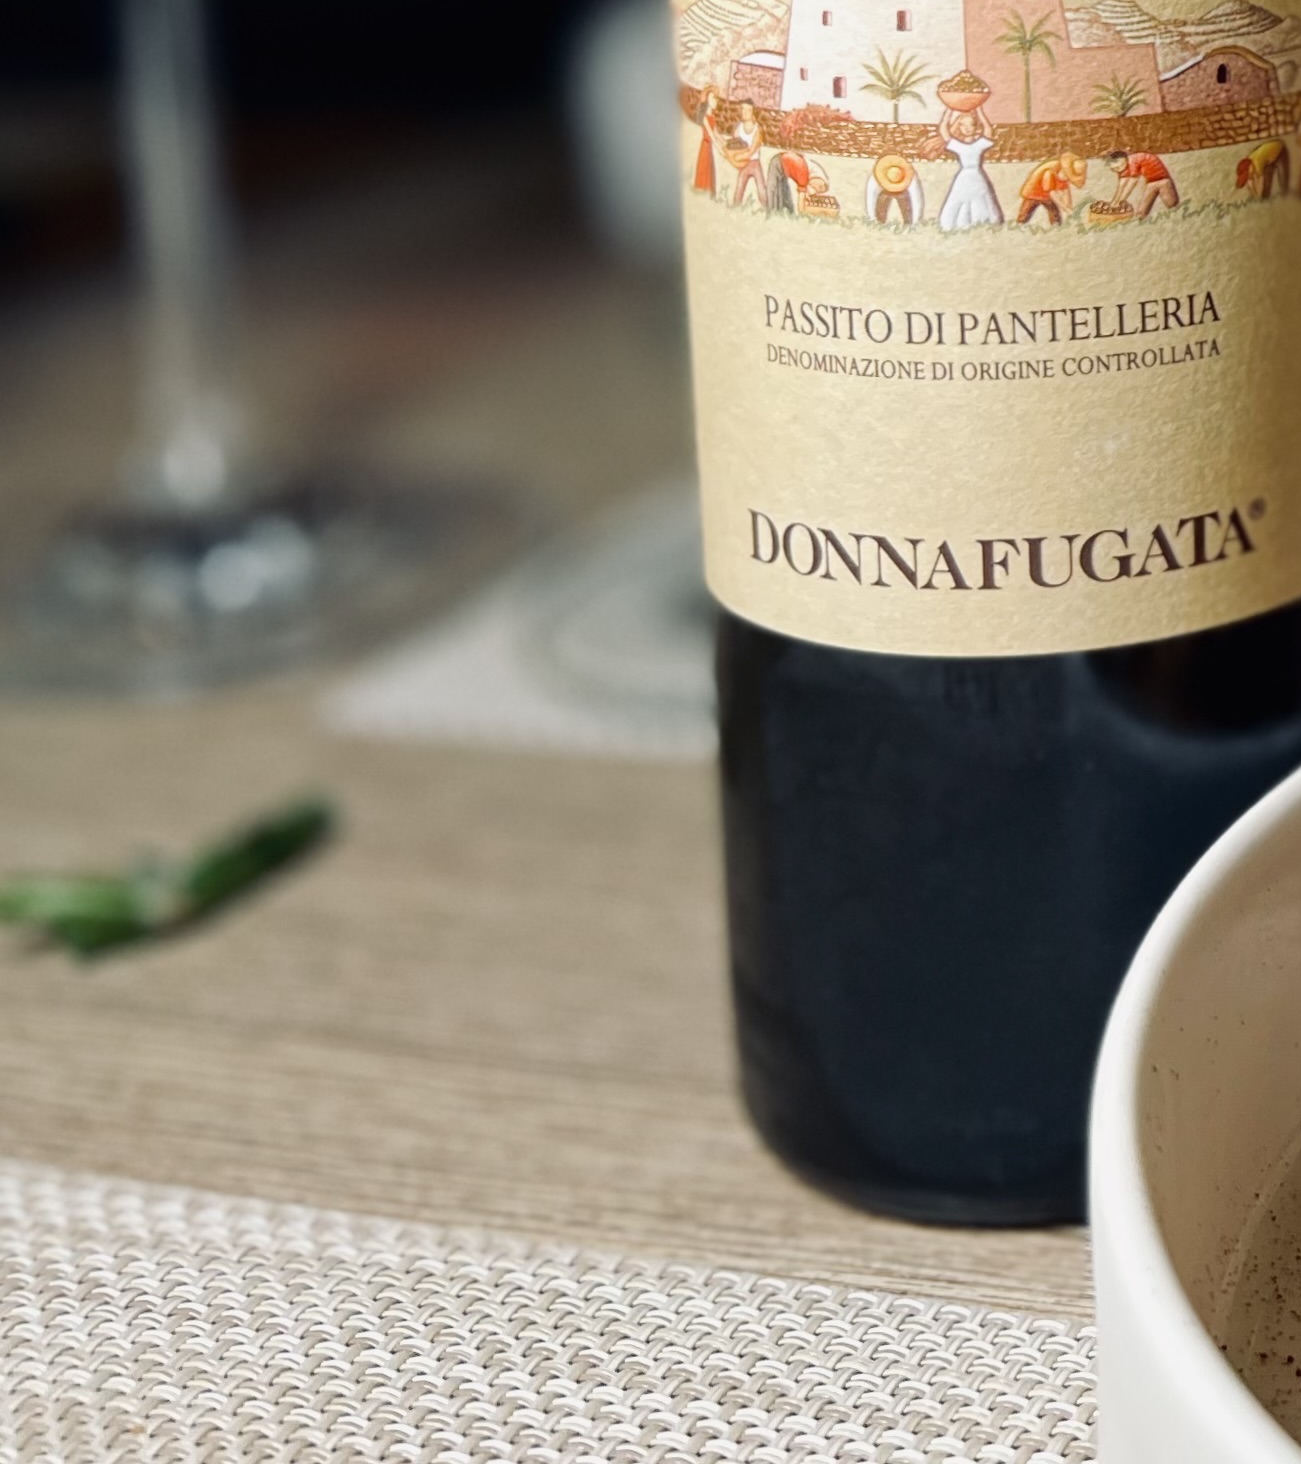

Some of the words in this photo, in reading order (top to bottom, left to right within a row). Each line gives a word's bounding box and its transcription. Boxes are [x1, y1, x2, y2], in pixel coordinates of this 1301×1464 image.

[764, 293, 894, 344] PASSITO
[905, 310, 946, 346] DI
[958, 290, 1221, 346] PANTELLERIA
[766, 343, 926, 381] DENOMINAZIONE
[931, 360, 955, 382] DI
[961, 358, 1055, 382] ORIGINE
[1061, 339, 1221, 378] CONTROLLATA
